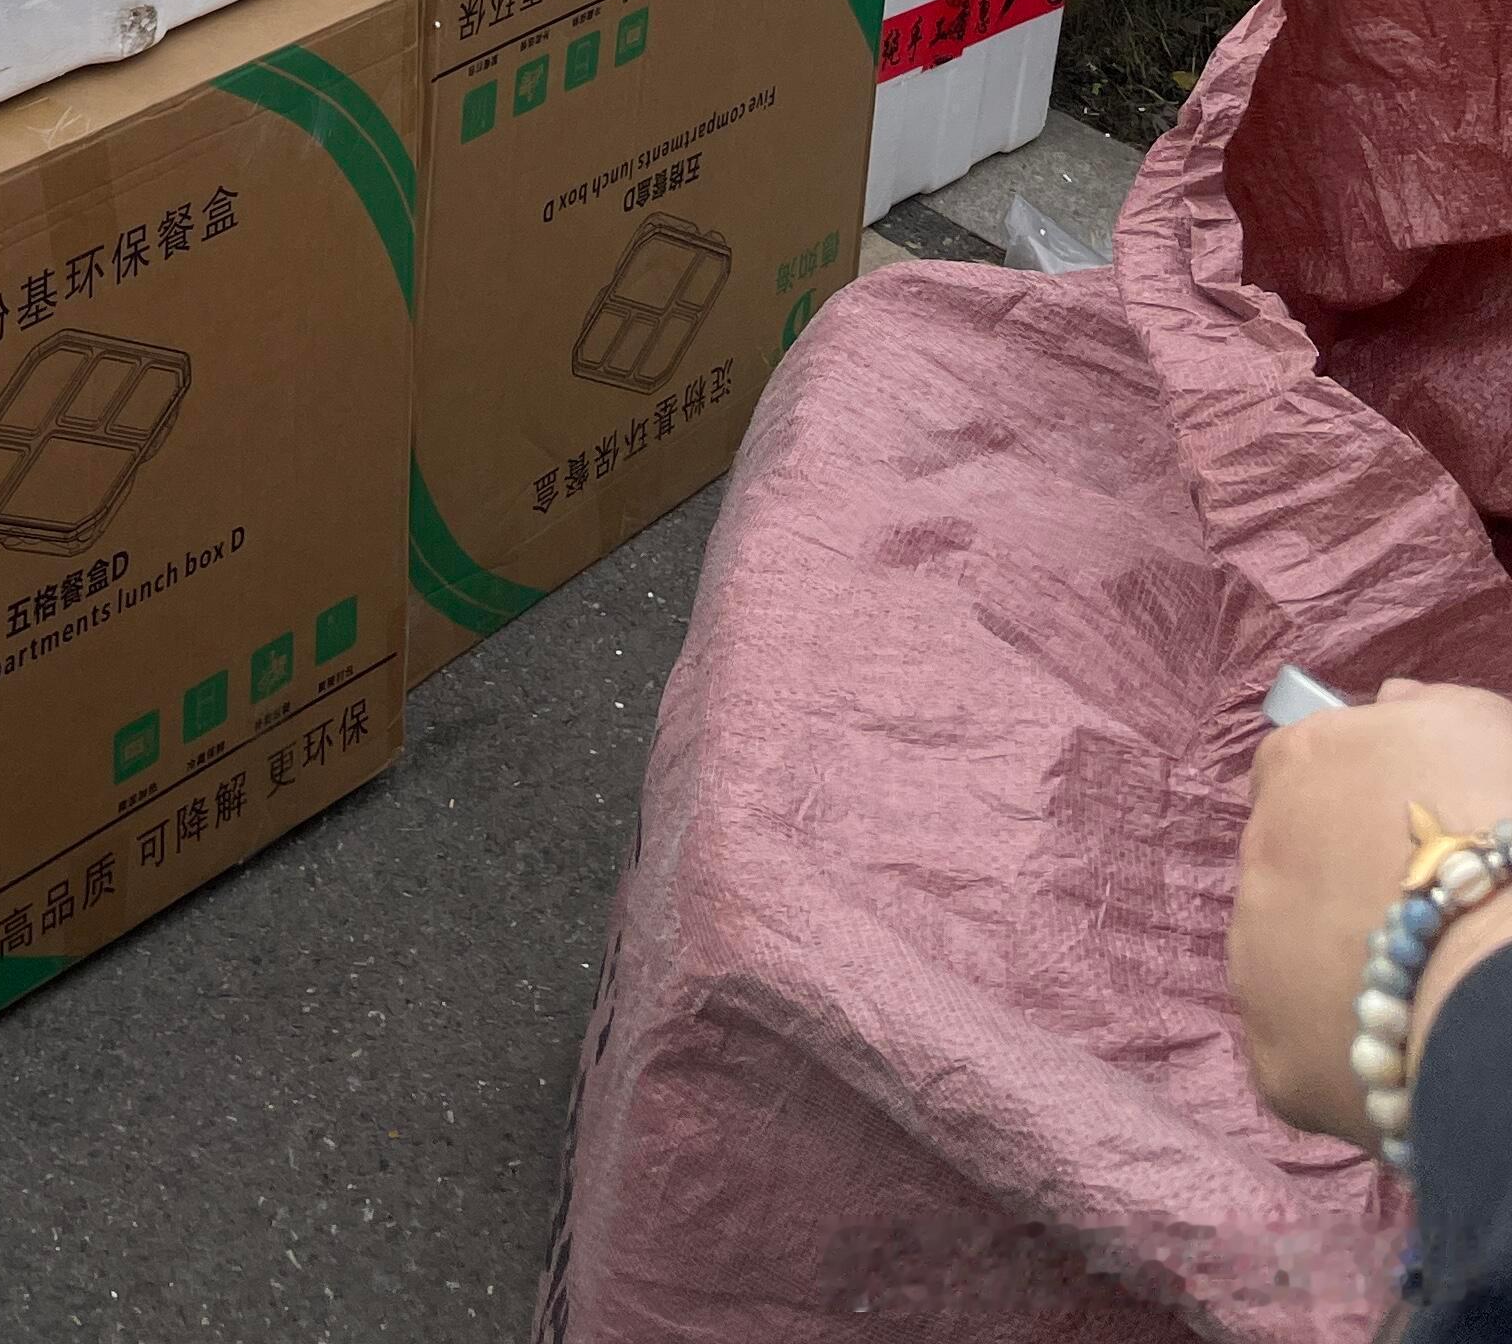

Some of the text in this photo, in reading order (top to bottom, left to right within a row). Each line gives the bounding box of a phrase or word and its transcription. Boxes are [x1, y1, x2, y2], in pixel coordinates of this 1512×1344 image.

[542, 85, 777, 223] Five compartments lunch box D
[623, 151, 703, 214] 五格餐盒D
[775, 228, 840, 296] 德如海
[532, 357, 734, 514] 淀粉基环保餐盒
[5, 550, 130, 639] 五格餐盒D
[117, 563, 180, 620] lunch
[184, 541, 227, 578] box
[231, 524, 247, 554] D
[137, 769, 248, 870] 可降解
[265, 697, 371, 801] 更环保
